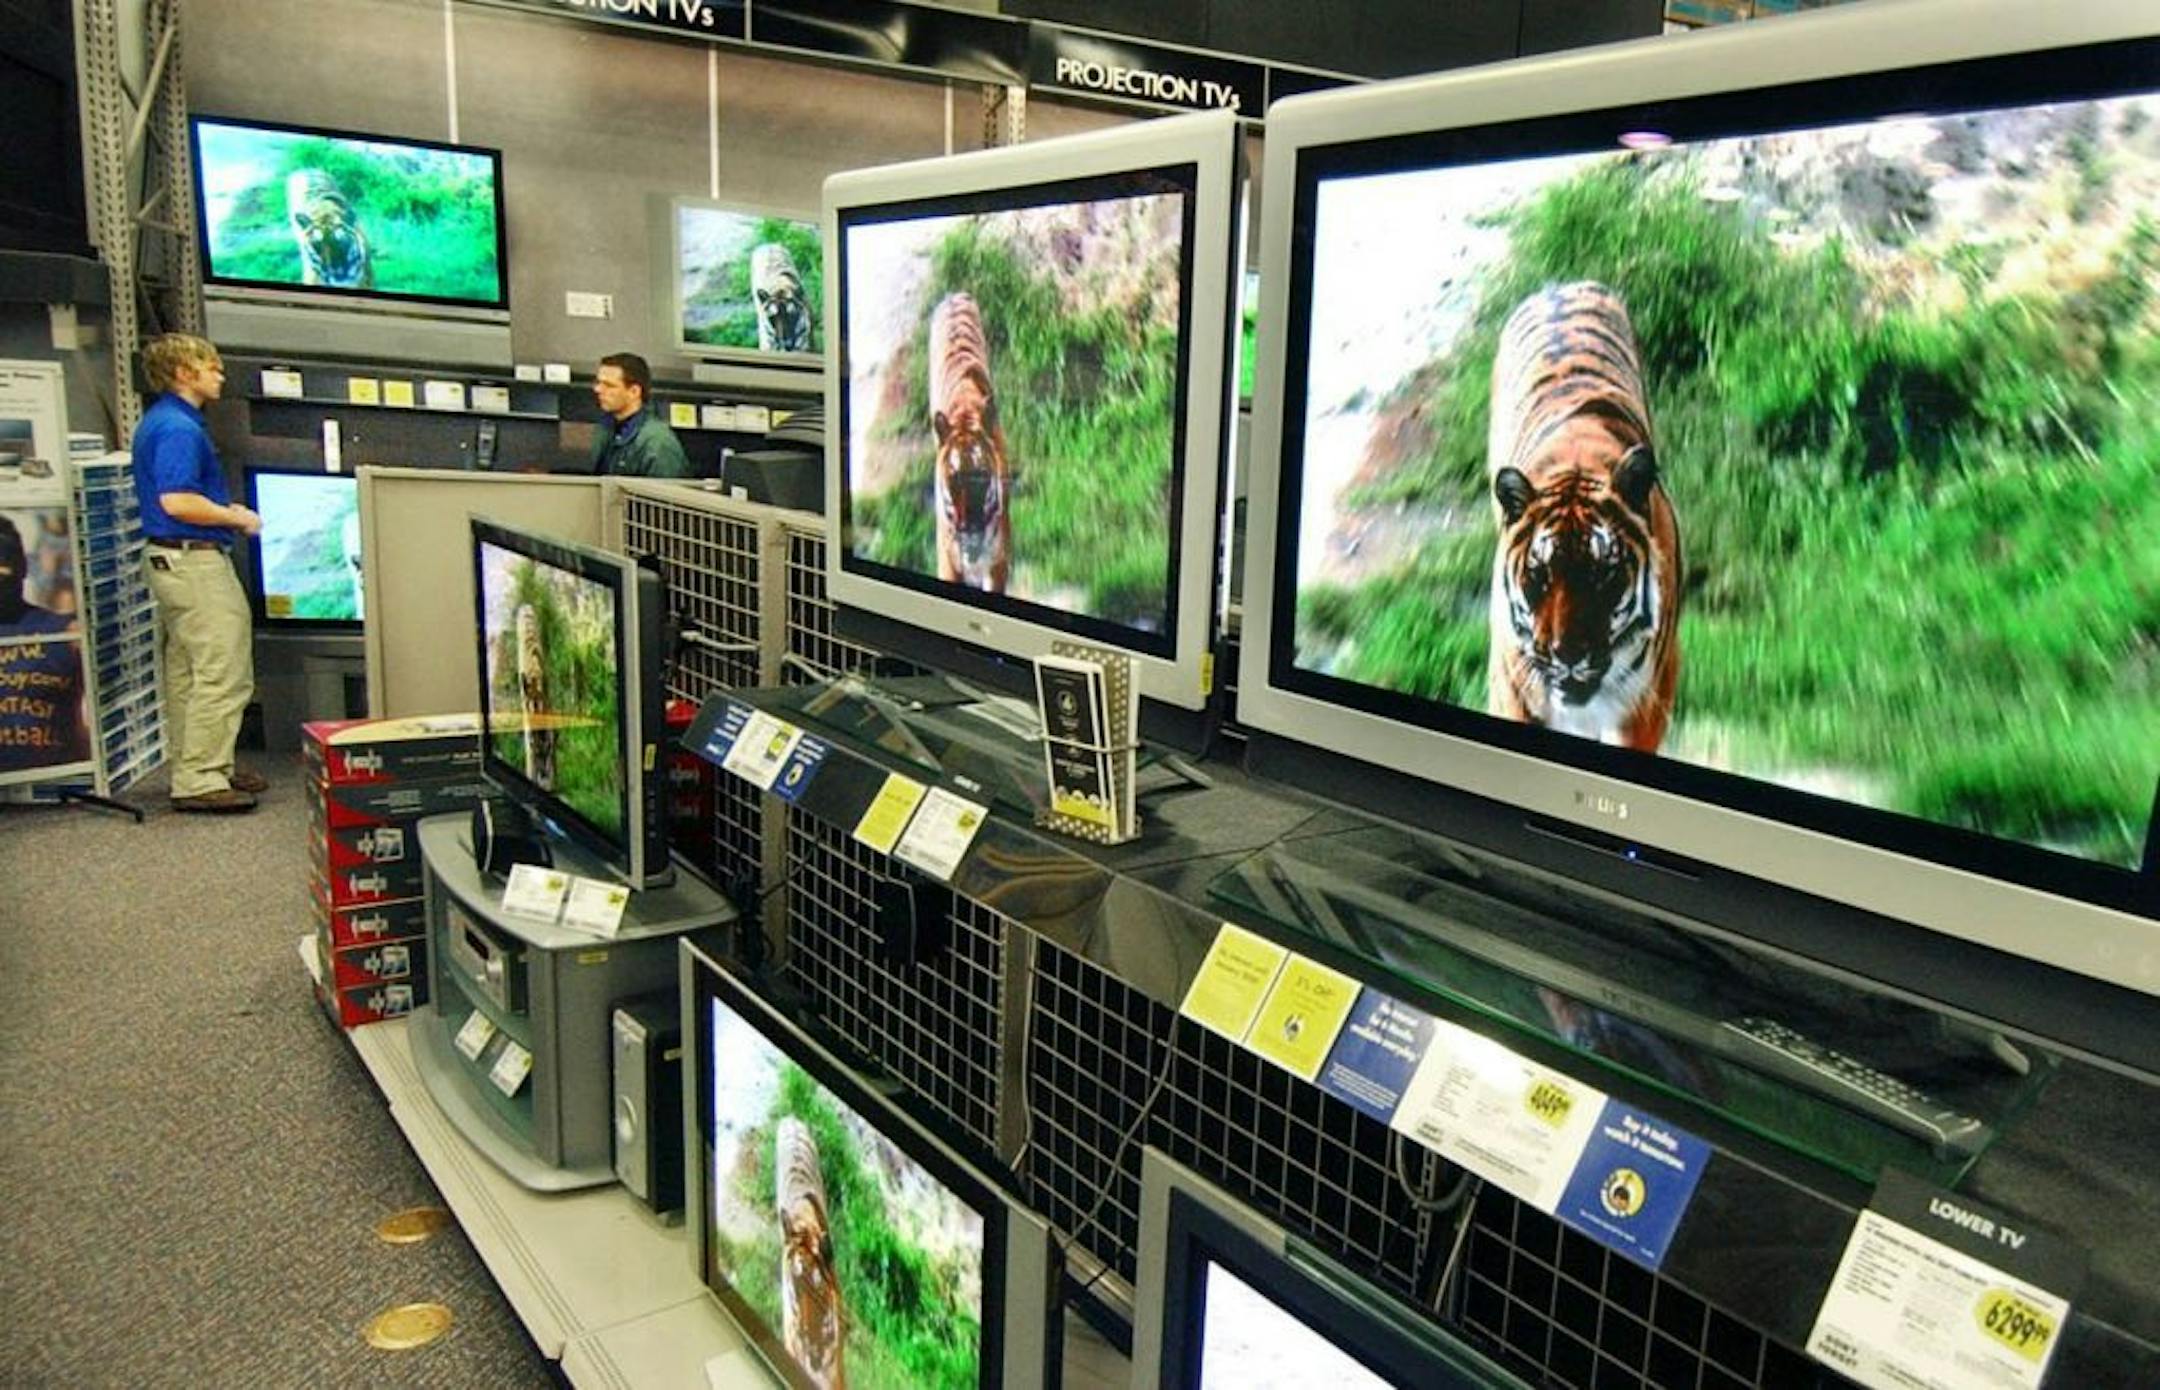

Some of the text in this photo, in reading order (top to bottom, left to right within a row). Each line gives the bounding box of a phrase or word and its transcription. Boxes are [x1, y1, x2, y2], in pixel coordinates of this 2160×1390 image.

[1056, 57, 1241, 109] PROJECTION TVs
[1929, 1197, 2026, 1250] LOWER TV
